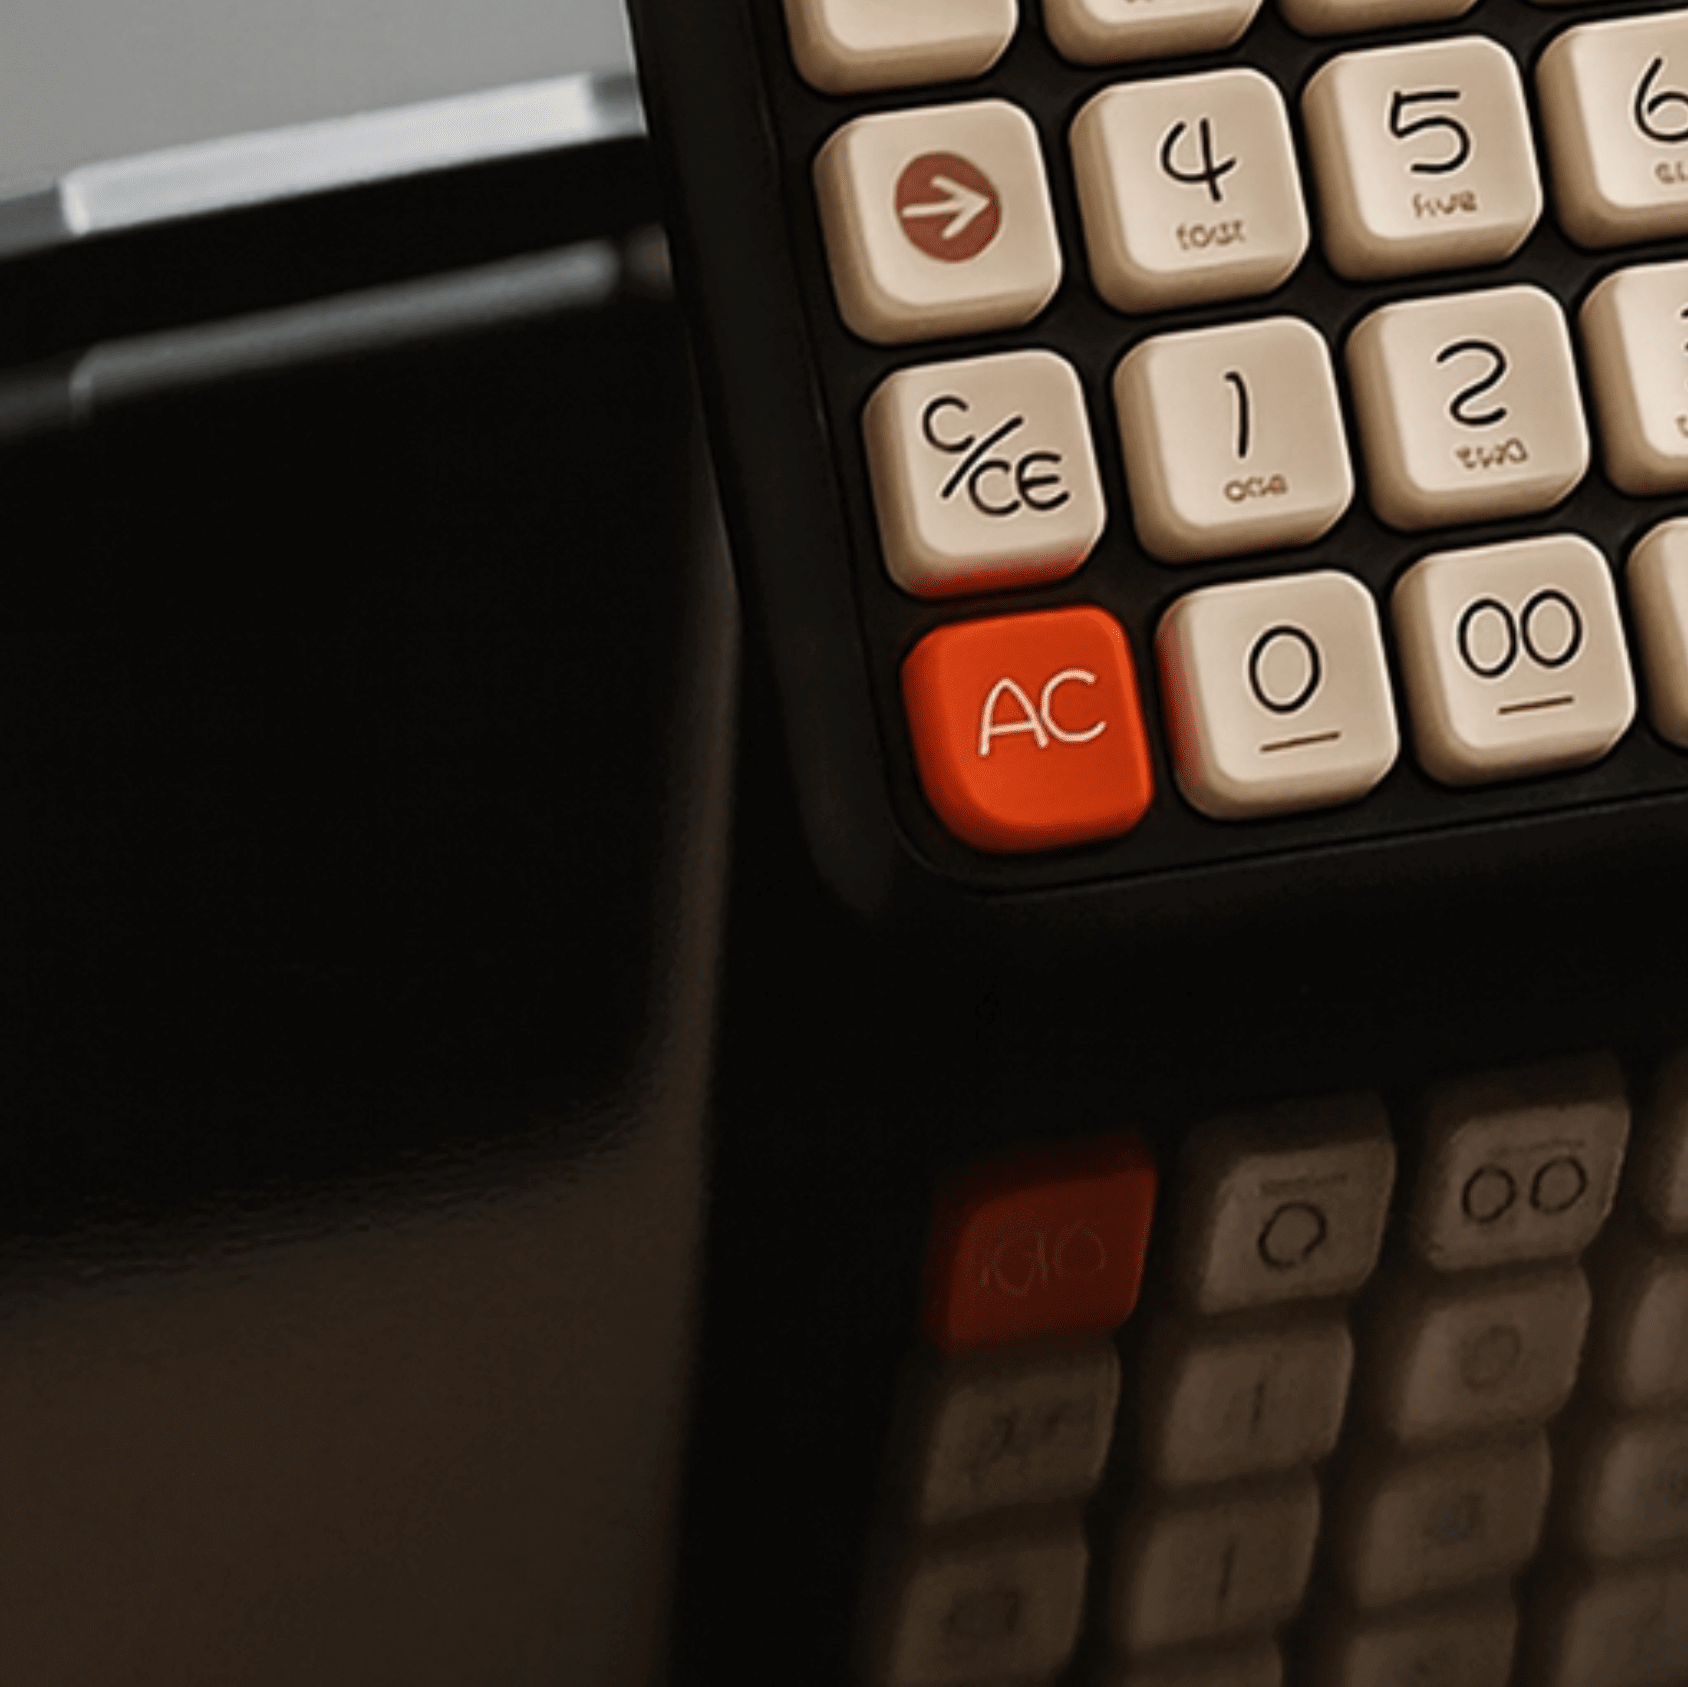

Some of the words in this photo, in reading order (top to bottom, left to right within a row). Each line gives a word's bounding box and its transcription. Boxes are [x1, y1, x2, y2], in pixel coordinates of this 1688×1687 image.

[1160, 118, 1236, 202] 4
[1389, 90, 1470, 175] 5
[1224, 371, 1250, 458] 1
[1436, 340, 1507, 427] 2
[922, 395, 1070, 517] C/CE
[1248, 625, 1321, 715] 0
[1457, 589, 1583, 679] 00
[980, 669, 1106, 756] AC
